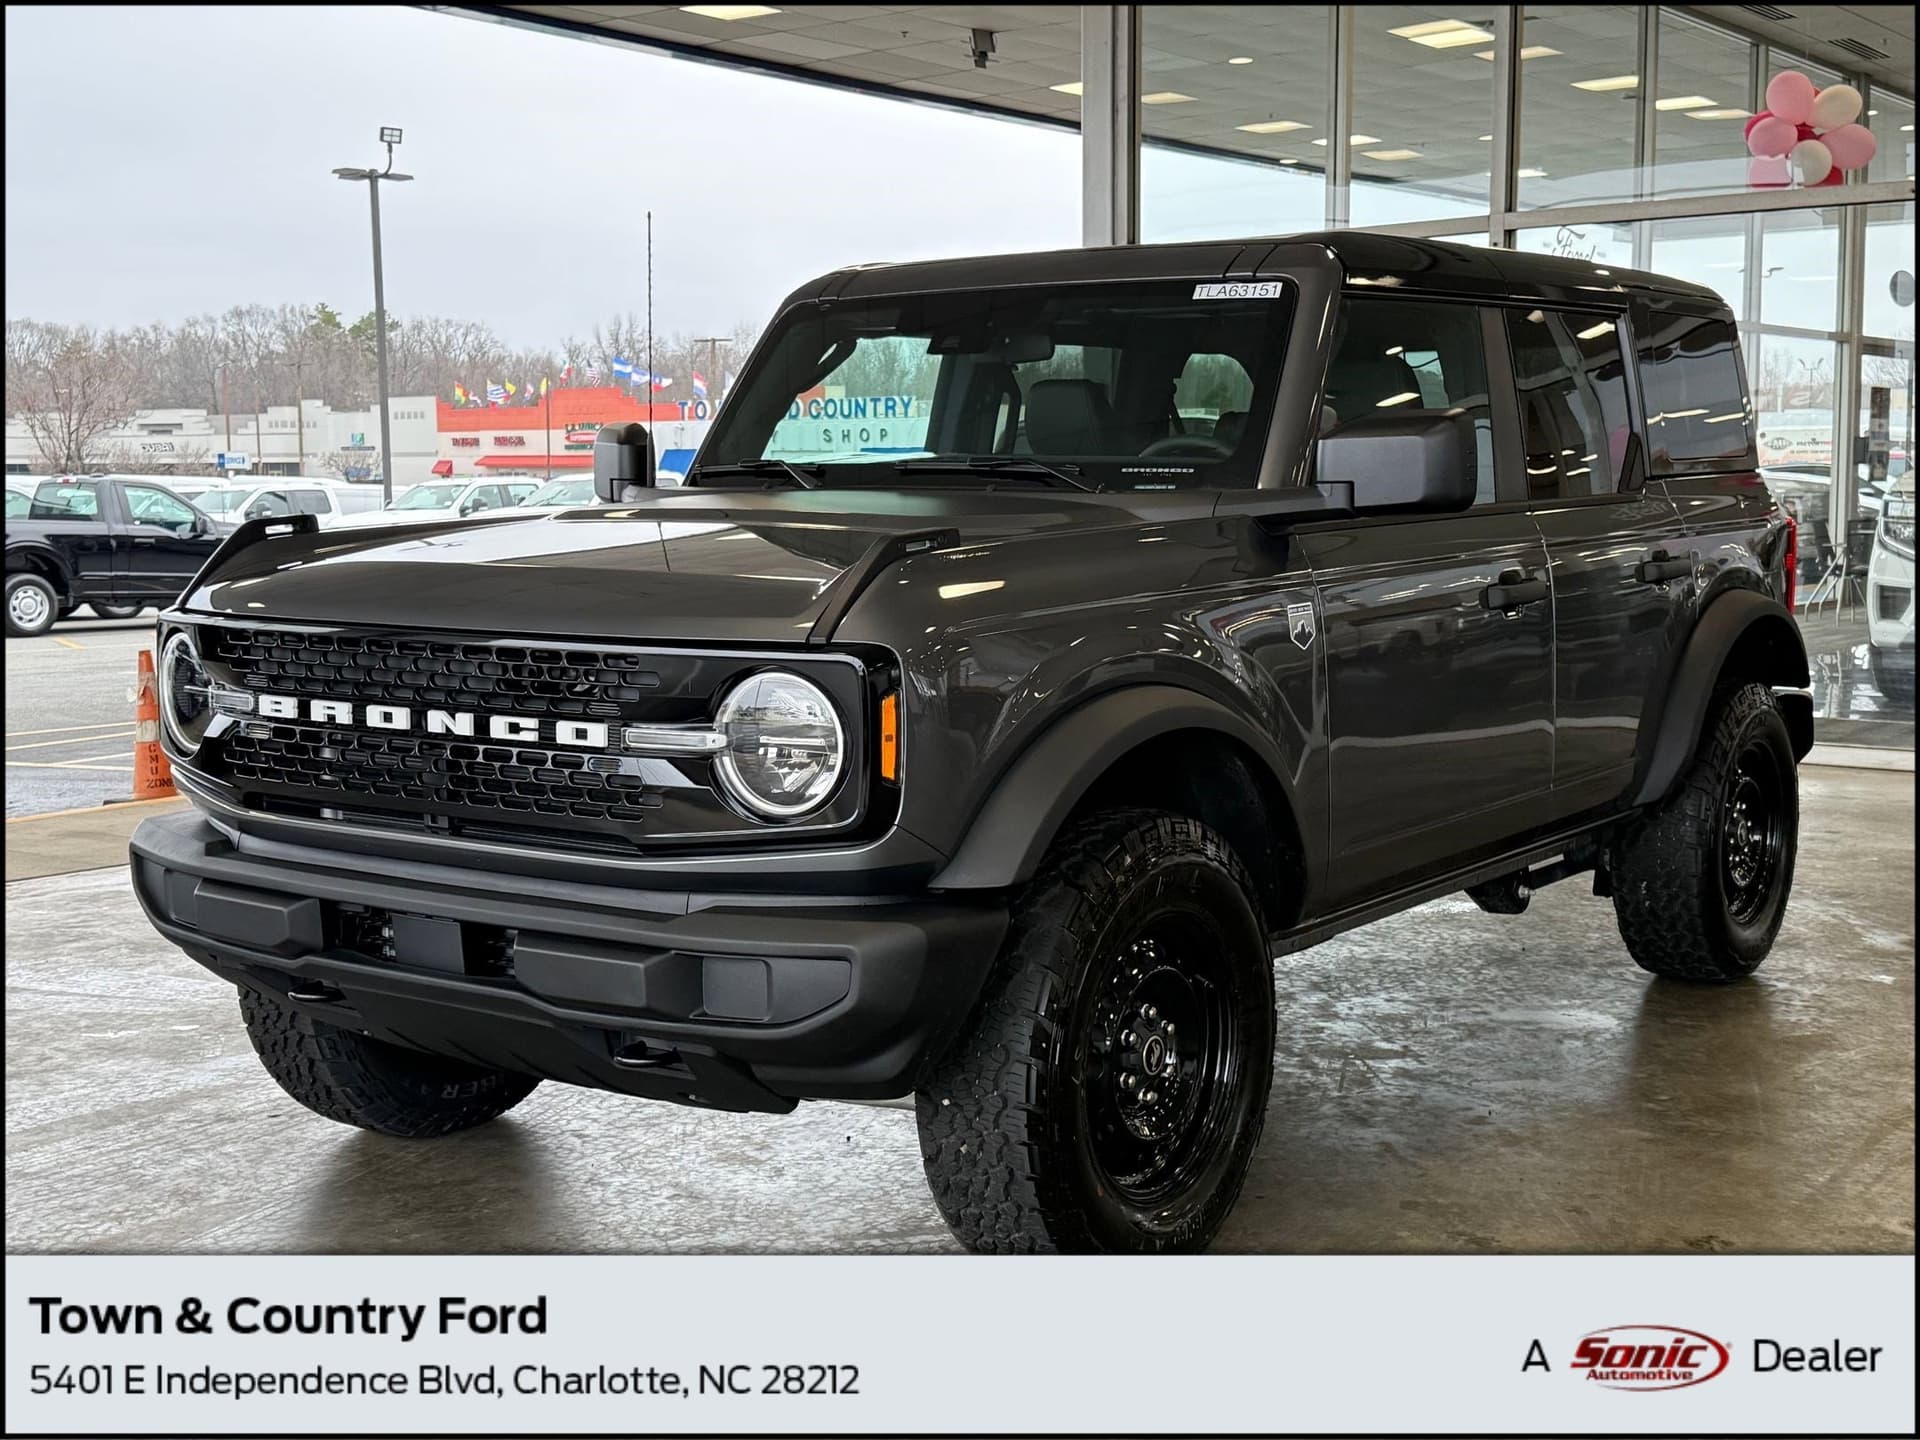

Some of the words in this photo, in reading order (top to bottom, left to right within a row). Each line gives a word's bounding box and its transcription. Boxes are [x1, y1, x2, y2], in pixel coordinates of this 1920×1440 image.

[1197, 284, 1279, 298] TLA63151
[678, 400, 722, 420] TO
[808, 397, 913, 420] COUNTRY
[822, 428, 888, 443] SHOP
[258, 693, 609, 748] BRONCO
